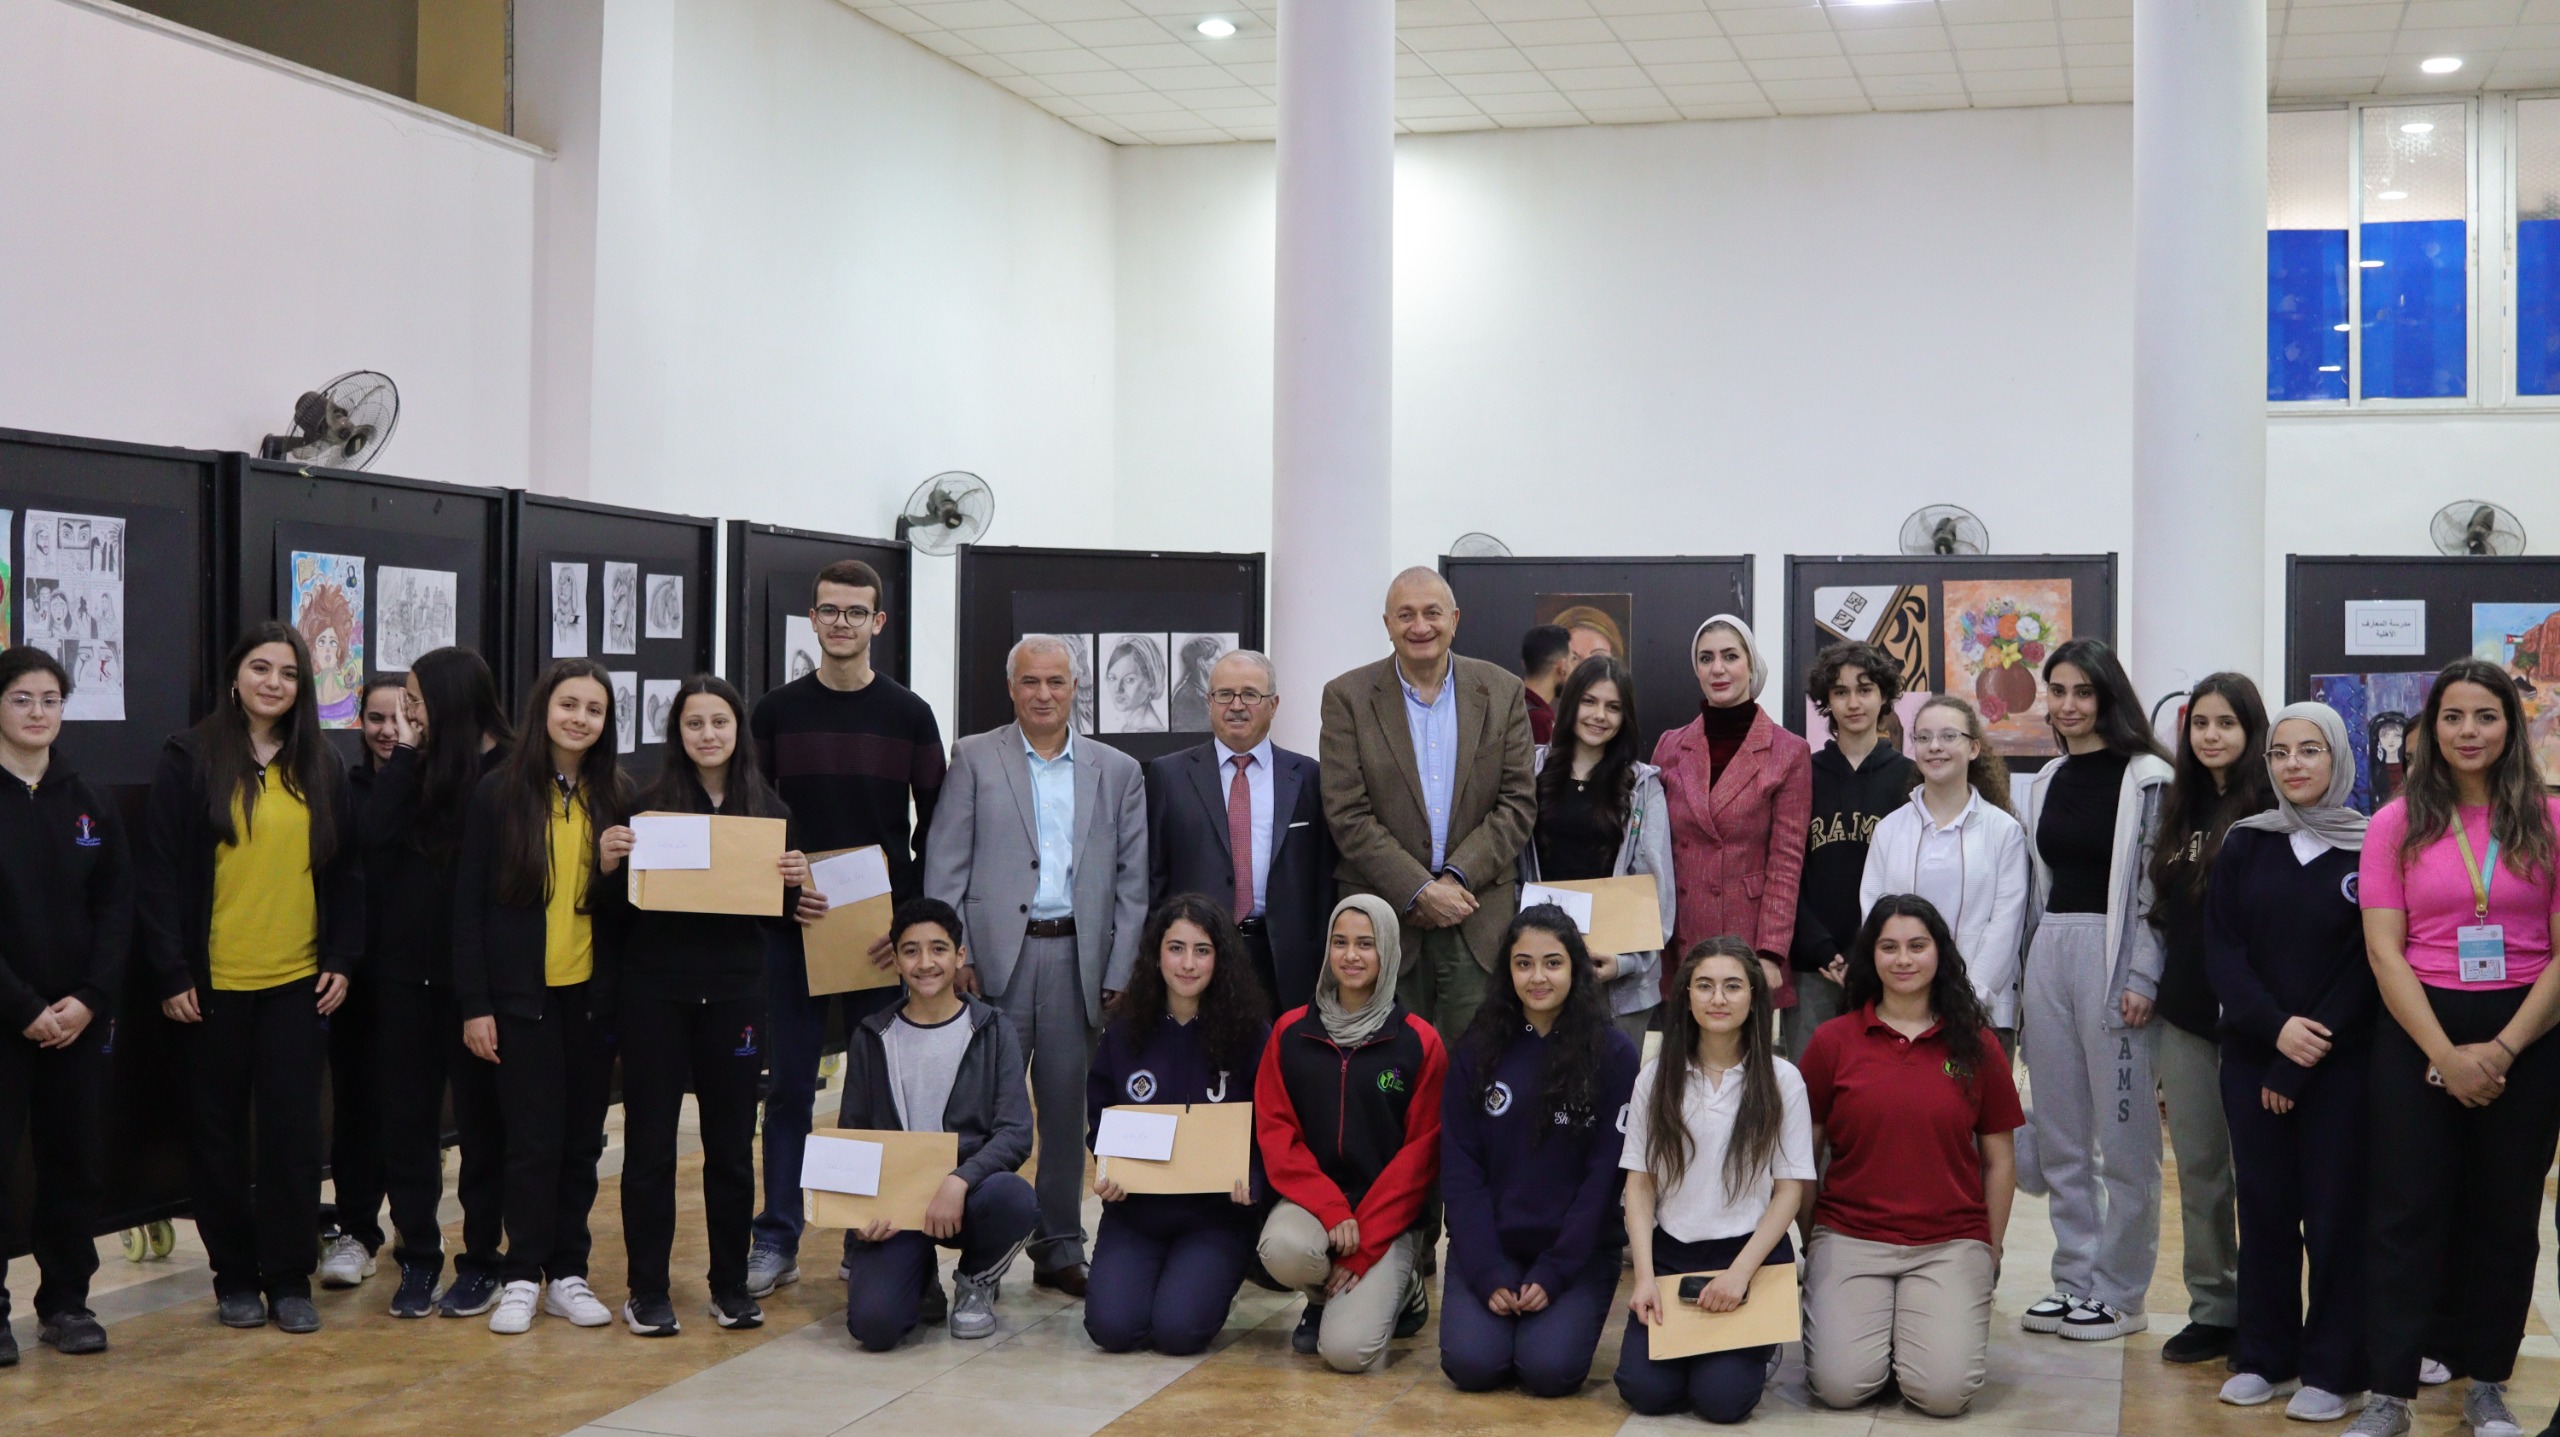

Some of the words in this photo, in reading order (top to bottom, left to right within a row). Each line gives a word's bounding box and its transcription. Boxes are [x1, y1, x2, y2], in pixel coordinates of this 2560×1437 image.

[2362, 620, 2387, 628] المعارف
[2389, 619, 2410, 628] مدرسة
[1206, 1070, 1230, 1103] J
